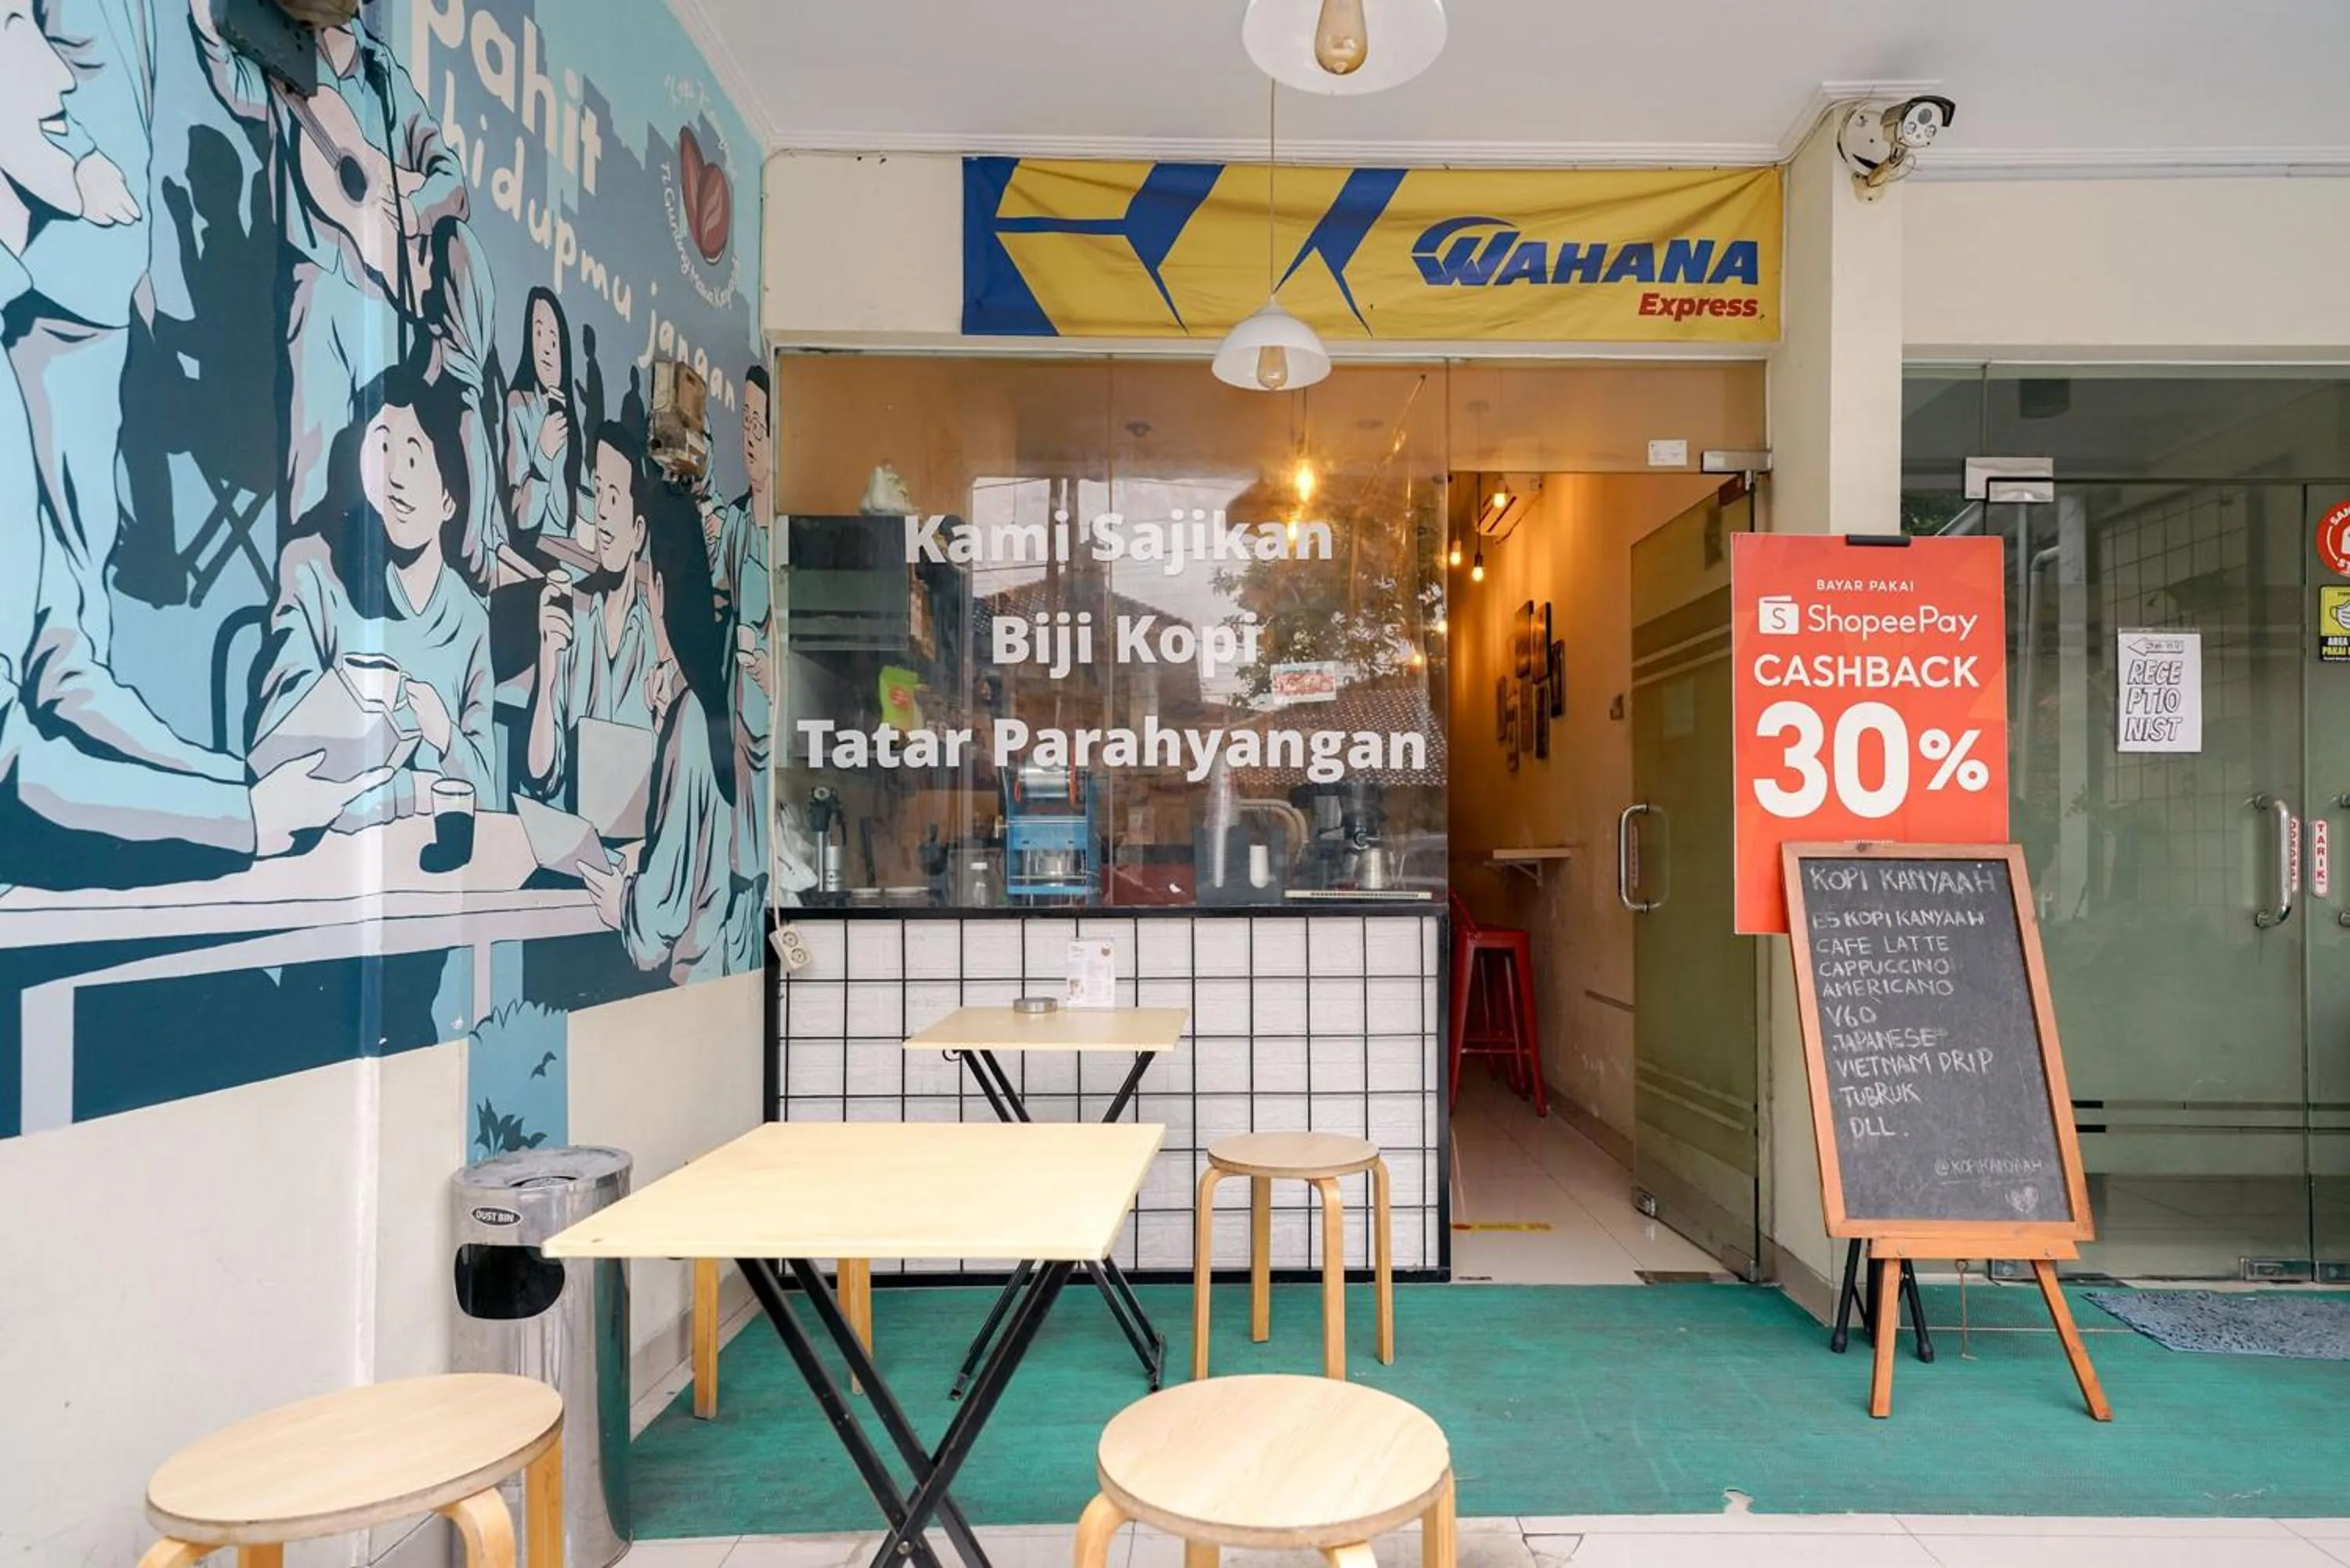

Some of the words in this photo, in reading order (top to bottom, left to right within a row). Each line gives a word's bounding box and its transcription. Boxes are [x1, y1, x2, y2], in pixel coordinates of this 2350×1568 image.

[412, 0, 602, 195] pahit
[1412, 217, 1759, 286] WAHANA
[1639, 292, 1759, 321] Express
[903, 512, 1069, 564] Kami
[1092, 508, 1332, 575] Sajikan
[1816, 580, 1864, 591] BAYAR
[1869, 581, 1914, 592] PAKAI
[1807, 604, 1979, 641] ShopeePay
[992, 612, 1092, 679] Biji
[1117, 612, 1258, 678] Kopi
[1754, 654, 1980, 688] CASHBACK
[2127, 659, 2184, 685] RECE
[2125, 687, 2182, 714] PTIO
[2124, 716, 2184, 742] NIST
[797, 720, 973, 768] Tatar
[993, 716, 1426, 783] Parahyangan
[1753, 700, 1990, 819] 30%
[2316, 823, 2326, 879] TARIK
[1810, 866, 1868, 891] KOPI
[1880, 867, 1997, 894] KANYAAH
[1813, 911, 1840, 930] ES
[1843, 910, 1893, 929] KOPI
[1816, 937, 1872, 956] CAFE
[1883, 935, 1950, 954] LATTE
[1818, 957, 1950, 977] CAPPUCCINO
[1823, 978, 1954, 1000] AMERICANO
[1835, 1051, 1932, 1078] VIETNAM
[1937, 1046, 1994, 1075] DRIP
[1838, 1081, 1922, 1108] TUBRUK
